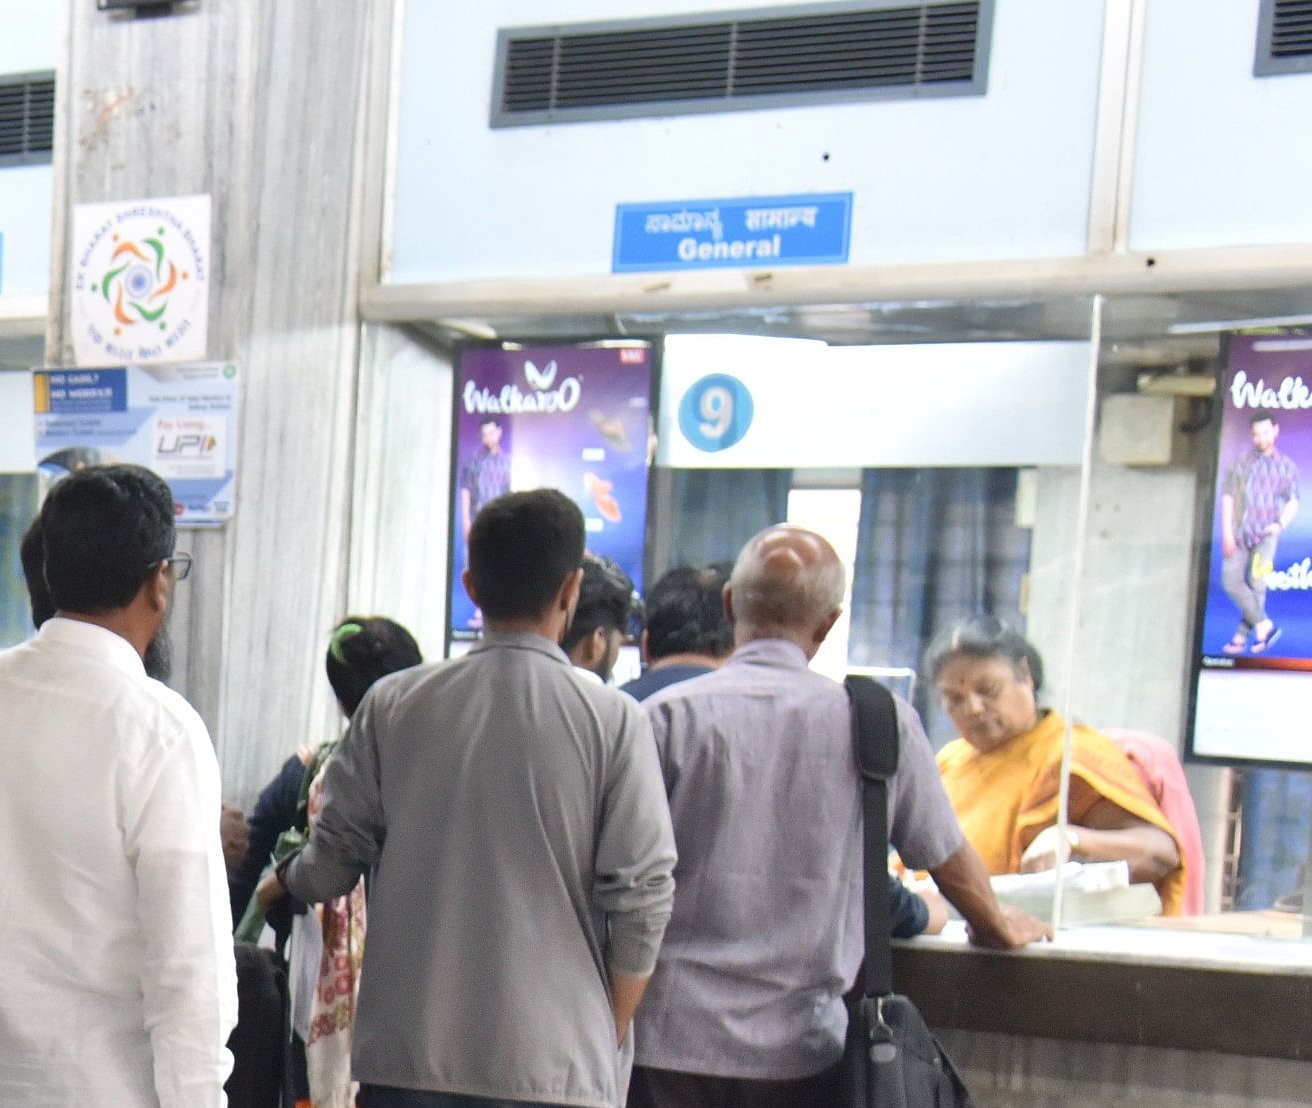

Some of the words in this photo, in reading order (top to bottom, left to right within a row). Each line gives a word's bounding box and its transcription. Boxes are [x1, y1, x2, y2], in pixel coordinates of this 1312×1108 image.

[745, 206, 818, 231] सामान्य
[678, 234, 781, 262] General
[699, 387, 733, 438] 9
[158, 434, 207, 454] UPI
